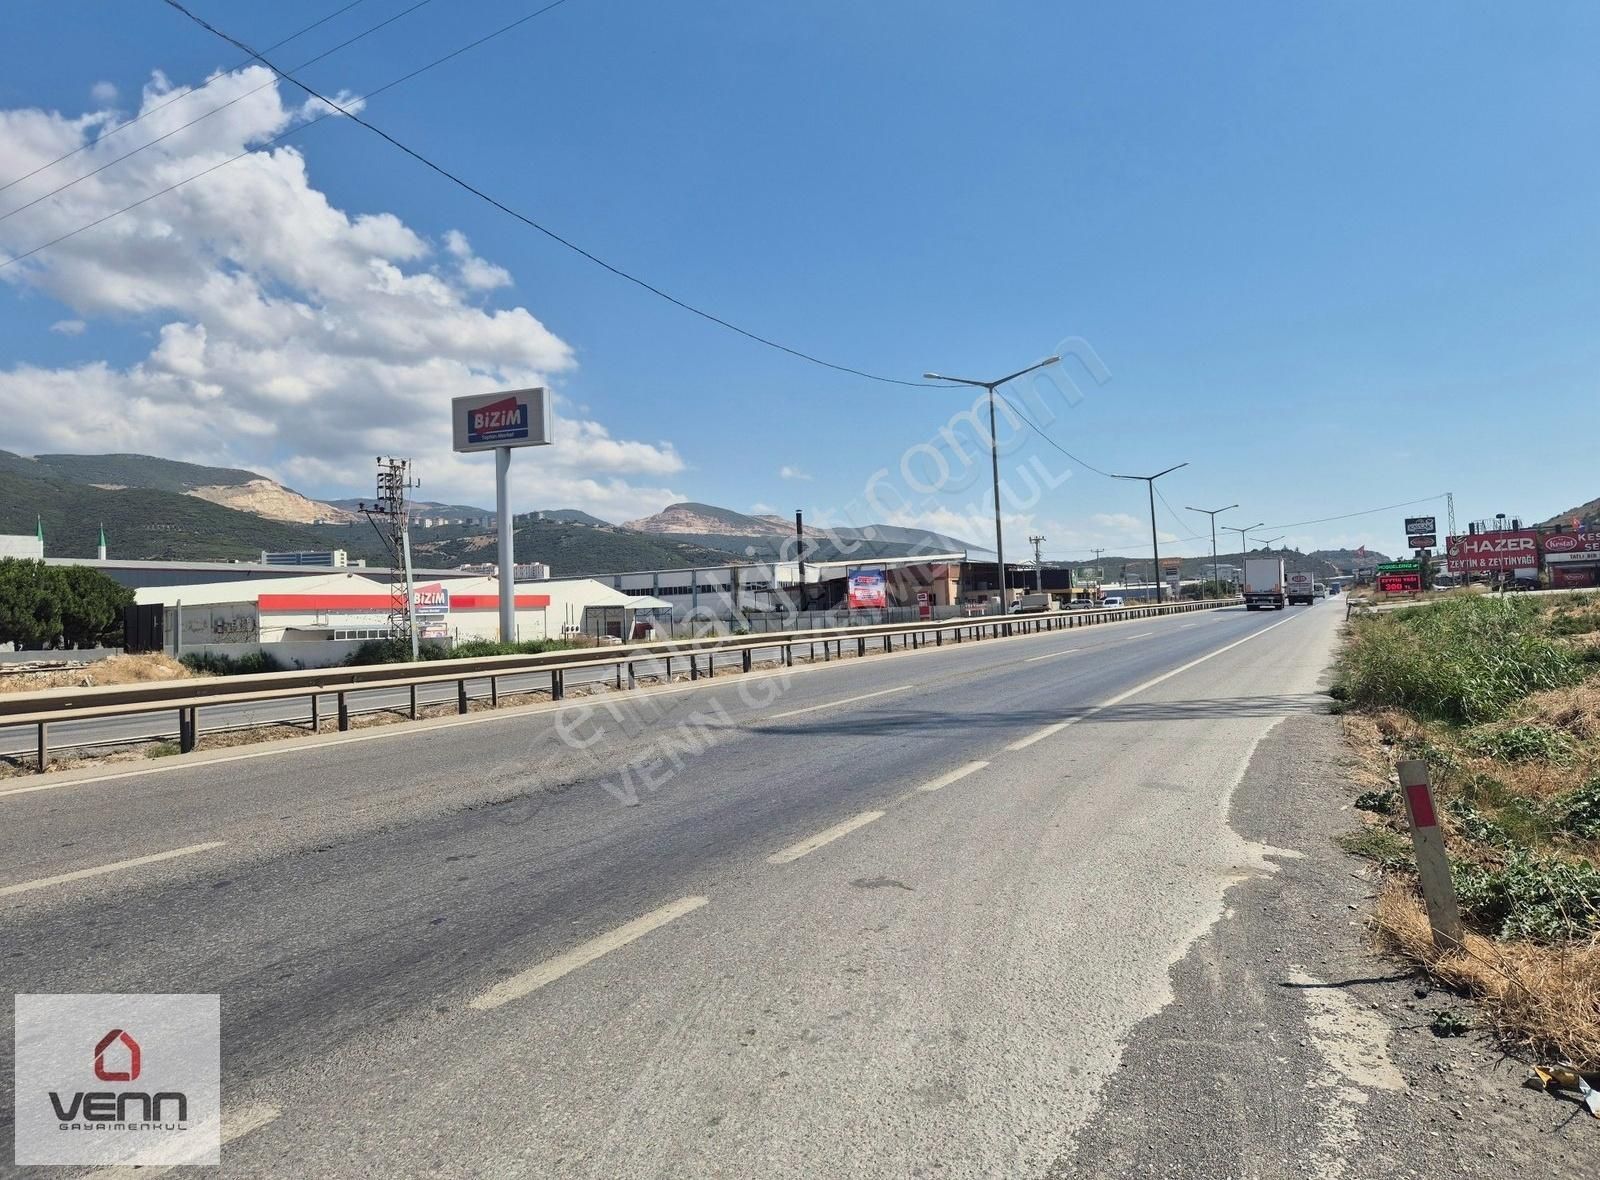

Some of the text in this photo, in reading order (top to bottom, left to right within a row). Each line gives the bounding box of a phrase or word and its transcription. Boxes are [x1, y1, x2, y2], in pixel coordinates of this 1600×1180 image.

[1463, 537, 1536, 554] HAZER
[1450, 553, 1535, 569] ZEYTİN & ZEYTİNYAĞI
